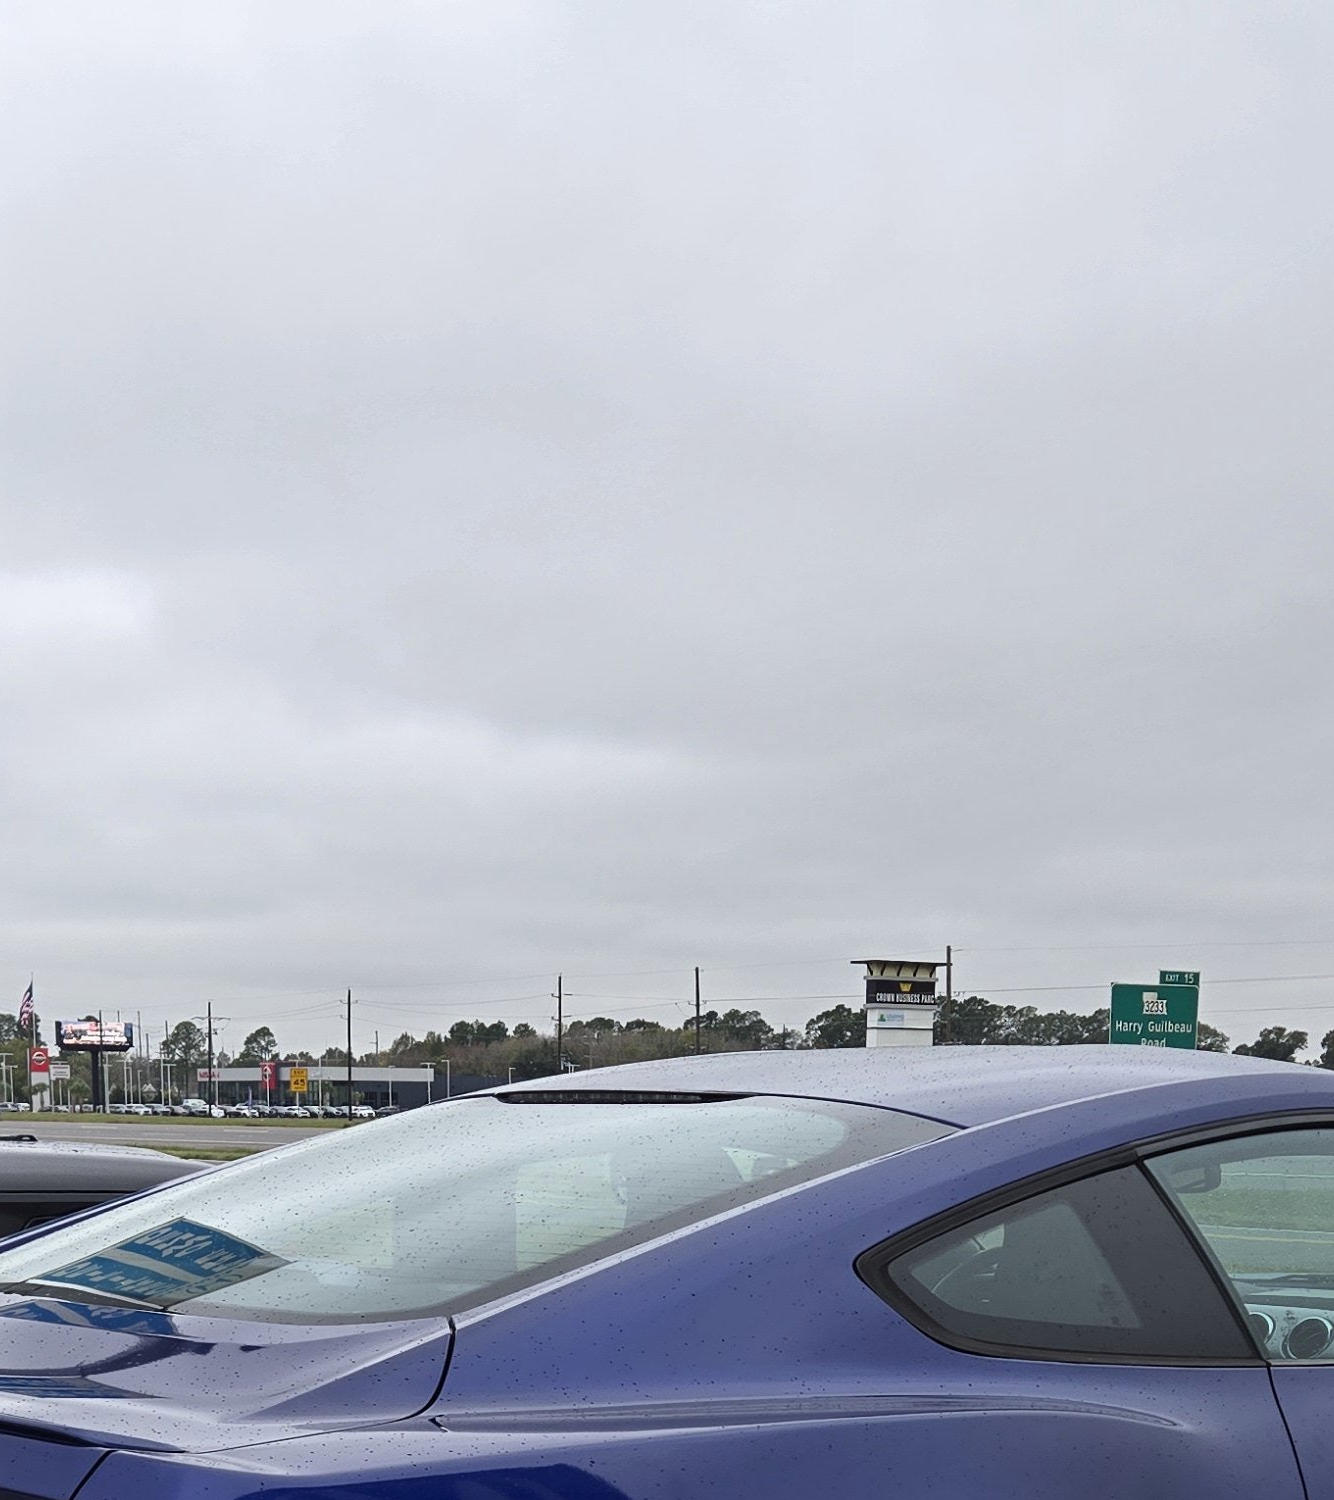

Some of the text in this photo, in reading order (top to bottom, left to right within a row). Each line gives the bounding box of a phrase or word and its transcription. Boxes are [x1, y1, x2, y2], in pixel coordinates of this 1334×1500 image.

[1165, 973, 1195, 984] EXIT 15
[896, 993, 920, 1003] BUSINESS
[1115, 1020, 1192, 1035] Harry Guilbeau
[293, 1079, 306, 1087] 45
